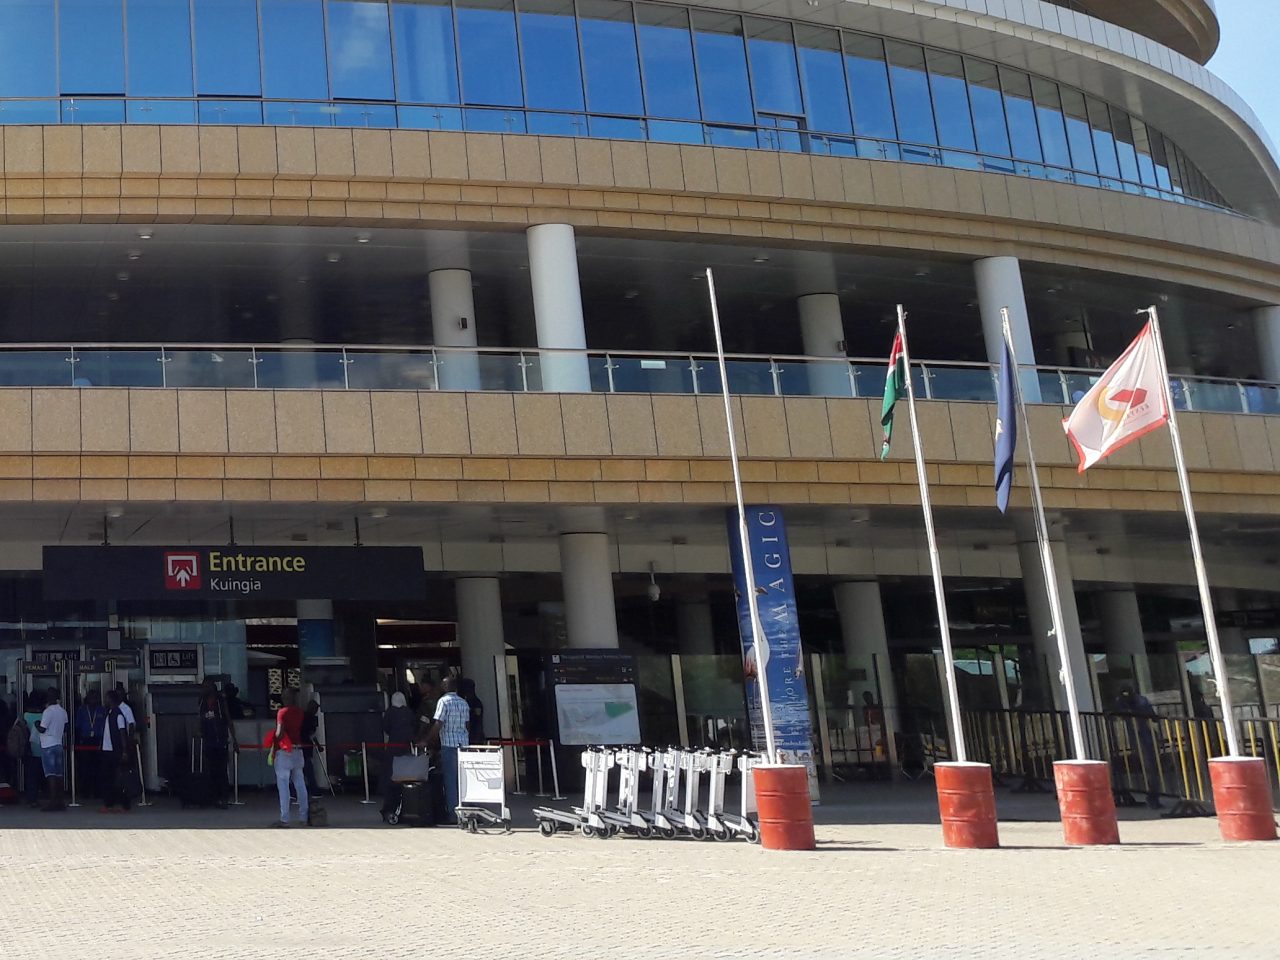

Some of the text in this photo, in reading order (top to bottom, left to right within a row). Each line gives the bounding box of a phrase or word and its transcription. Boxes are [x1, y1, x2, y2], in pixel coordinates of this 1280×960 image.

[209, 552, 305, 572] Entrance
[758, 511, 790, 624] MAGIC
[210, 577, 261, 593] Kuingia
[778, 629, 790, 659] THE
